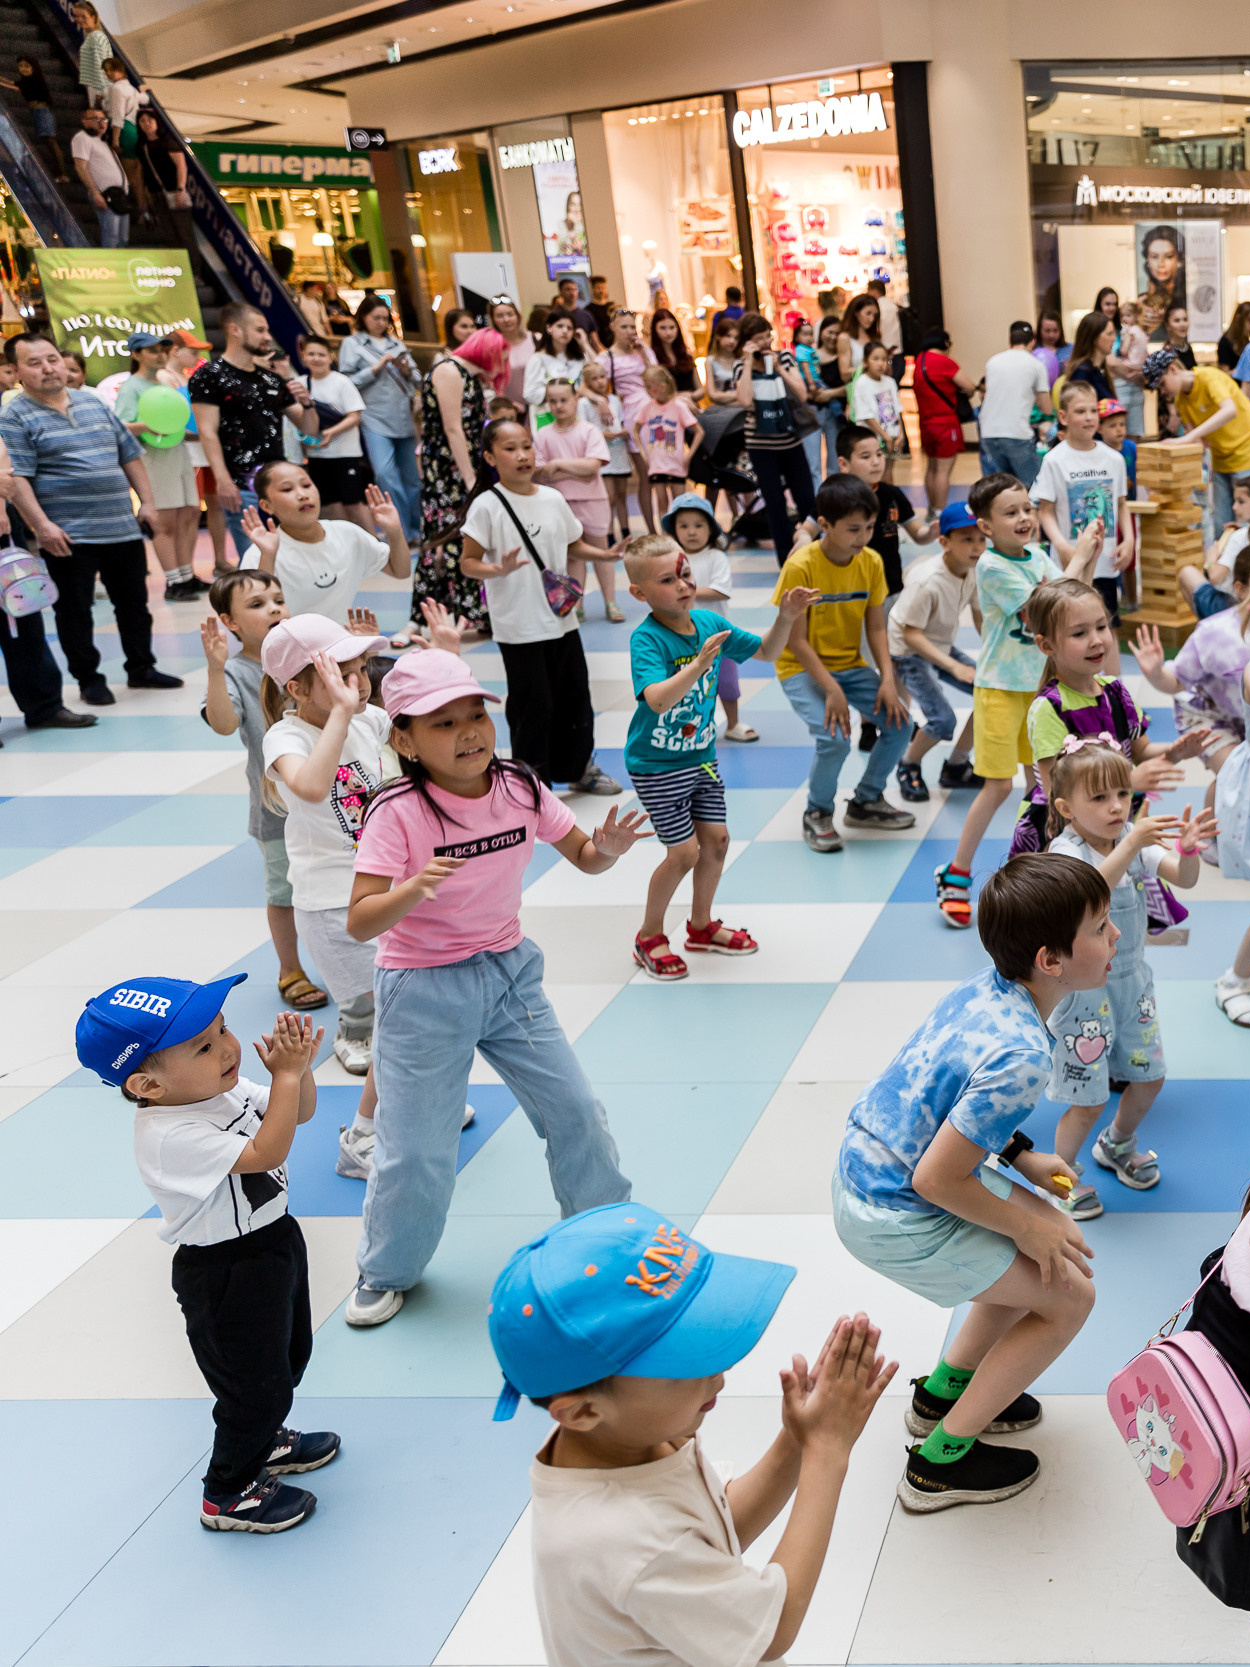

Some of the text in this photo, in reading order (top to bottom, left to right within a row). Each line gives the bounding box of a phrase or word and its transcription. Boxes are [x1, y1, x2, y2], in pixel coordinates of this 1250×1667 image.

[733, 92, 888, 148] CALZEDONIA
[418, 147, 459, 175] BORK
[498, 136, 576, 170] БАНКОМАТЫ
[218, 153, 375, 183] гиперма
[1100, 184, 1201, 204] МОСКОВСКИЙ
[480, 840, 489, 851] В
[491, 831, 522, 849] ОТЦА
[109, 988, 172, 1018] SIBIR
[111, 1041, 140, 1070] СИБИРЬ
